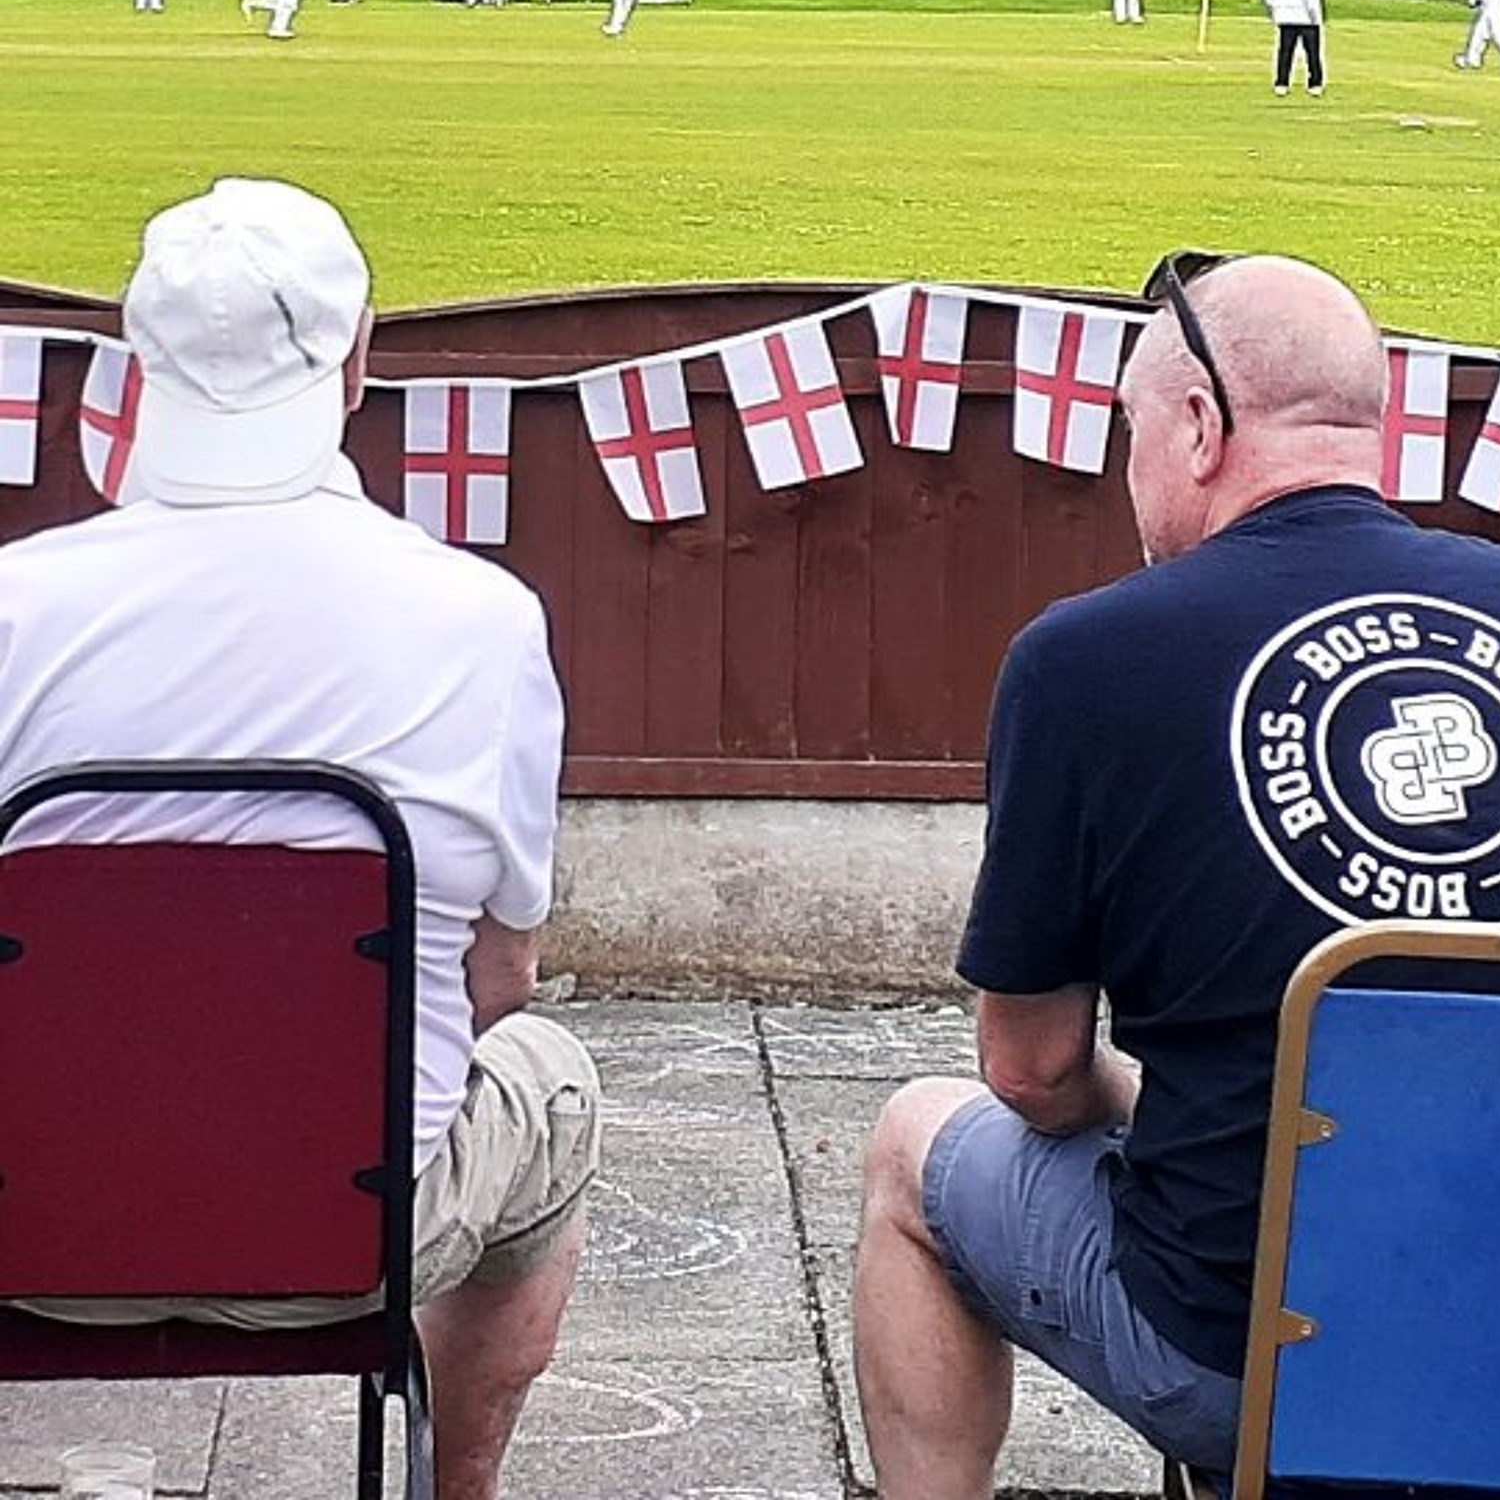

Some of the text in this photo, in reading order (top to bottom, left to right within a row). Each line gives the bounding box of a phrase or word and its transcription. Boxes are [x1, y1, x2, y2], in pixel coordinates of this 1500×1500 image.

[1294, 613, 1420, 680] BOSS
[1260, 711, 1327, 839] BOSS
[1339, 853, 1470, 917] BOSS
